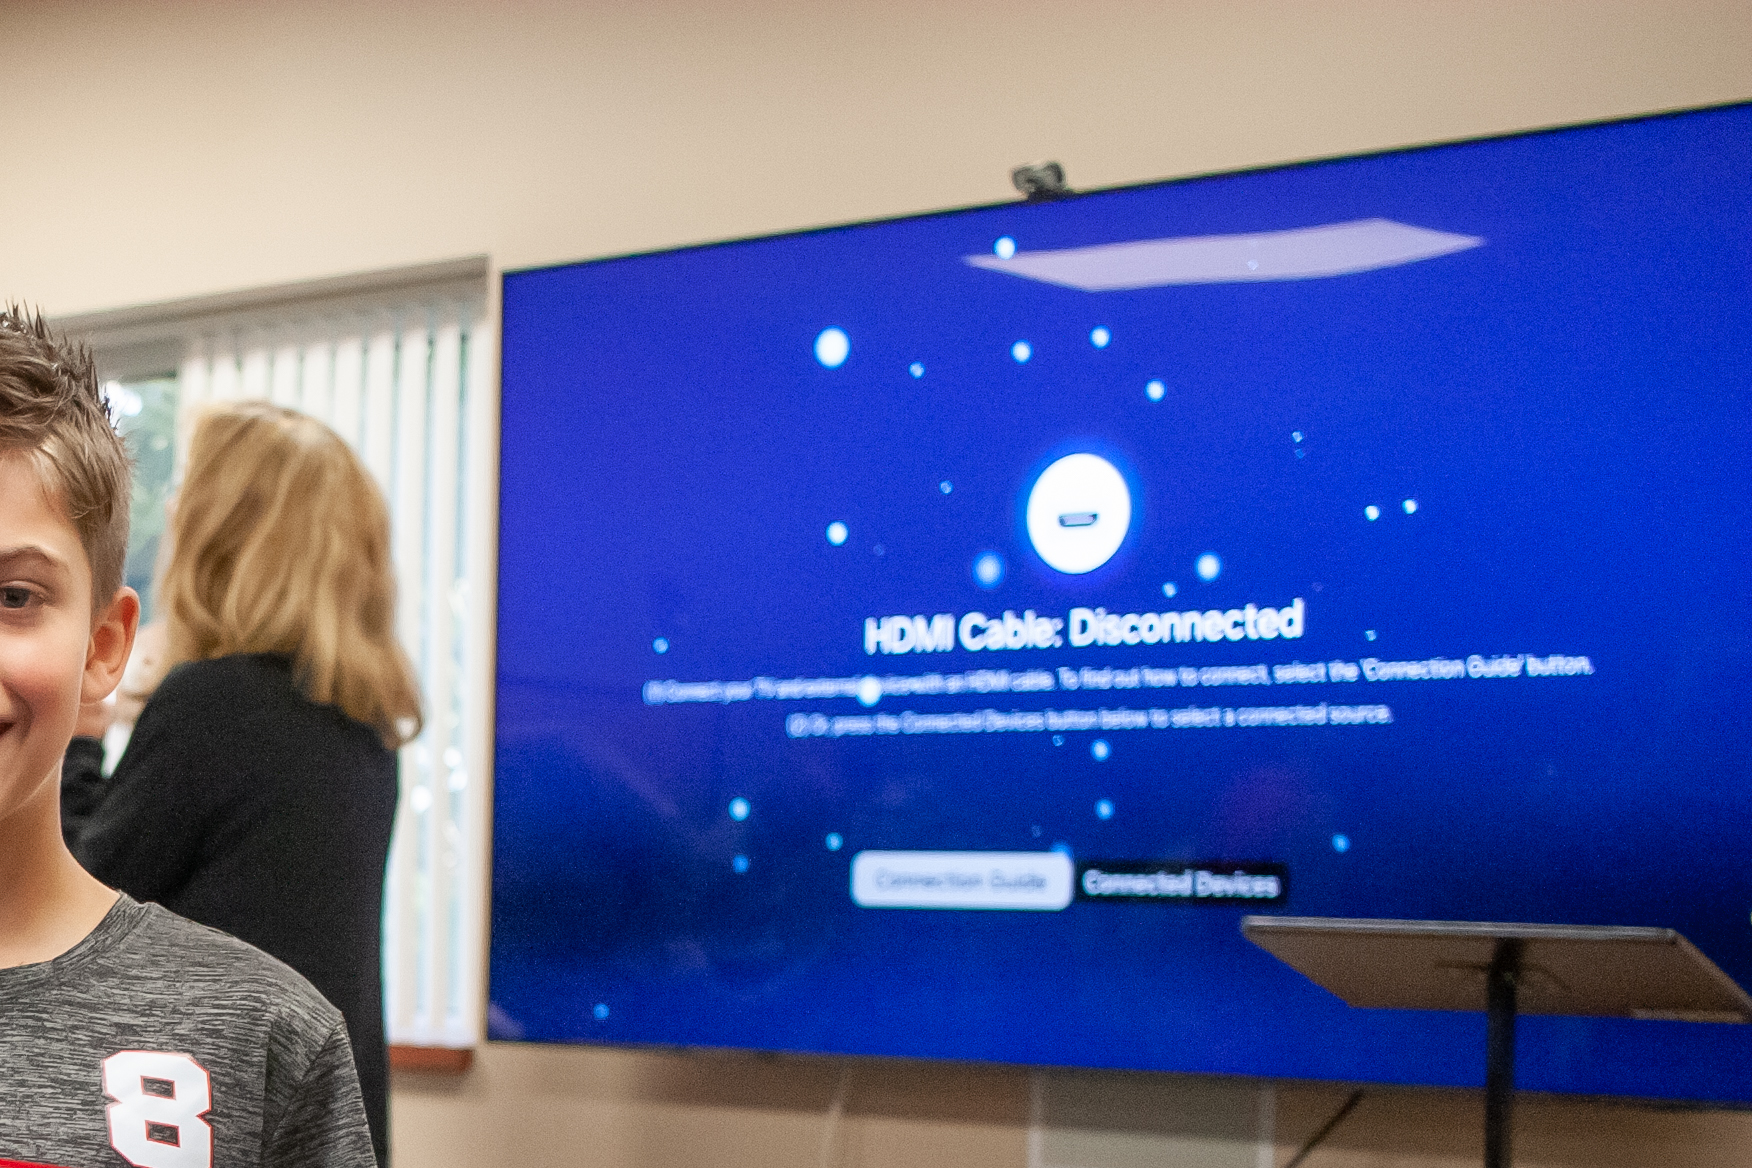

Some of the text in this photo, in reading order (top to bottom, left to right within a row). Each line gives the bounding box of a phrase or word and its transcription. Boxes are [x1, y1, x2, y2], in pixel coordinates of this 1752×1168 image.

[864, 597, 1305, 654] HDMI Cable: Disconnected
[1273, 660, 1326, 684] select
[1327, 659, 1360, 682] the
[1082, 868, 1281, 898] Connected Devices
